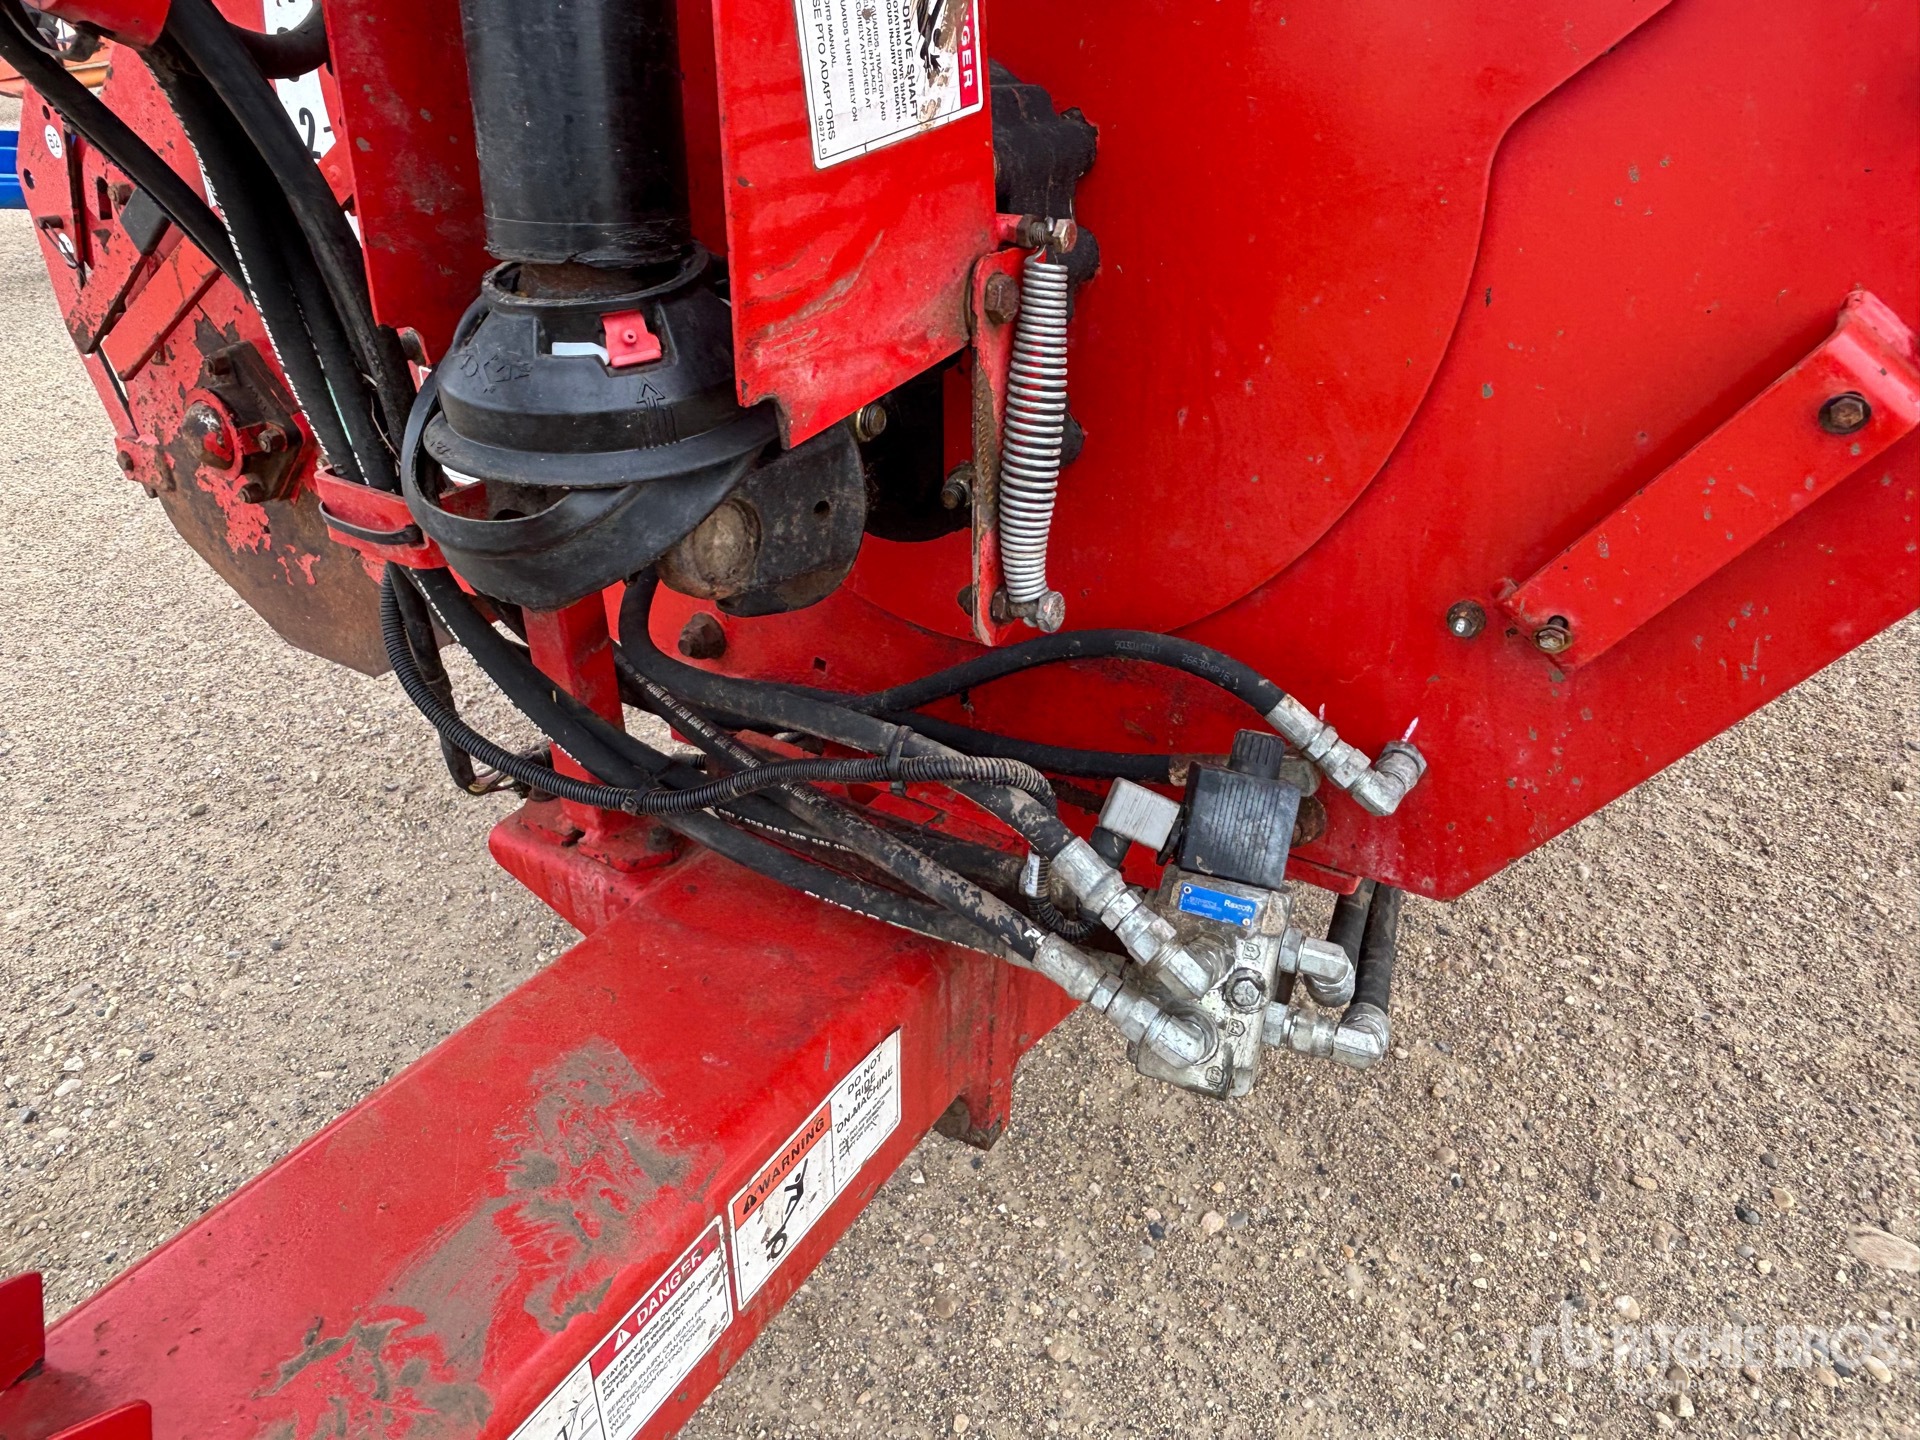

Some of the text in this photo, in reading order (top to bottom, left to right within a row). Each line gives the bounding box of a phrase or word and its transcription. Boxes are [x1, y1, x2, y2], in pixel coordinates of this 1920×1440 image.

[816, 23, 827, 55] PTO
[827, 22, 837, 68] MANUAL
[843, 37, 853, 66] TURN
[888, 27, 897, 66] INJURY
[902, 5, 918, 119] DRIVE SHAFT
[847, 68, 856, 104] FREELY
[859, 43, 870, 96] ATTACHED
[876, 52, 885, 99] TRACTOR
[819, 59, 836, 141] ADAPTORS
[851, 105, 859, 122] ON
[864, 97, 871, 109] AT
[879, 101, 887, 122] AND
[847, 1051, 883, 1095] DO NOT
[854, 1071, 876, 1101] RIDE
[836, 1113, 852, 1134] ON
[852, 1065, 893, 1118] MACHINE
[759, 1117, 825, 1194] WARNING
[637, 1248, 703, 1326] DANGER
[601, 1280, 696, 1387] STAY AWAY FROM OVERHEAD
[664, 1341, 679, 1361] CAN
[602, 1364, 630, 1395] POWER
[629, 1342, 650, 1365] LINES
[604, 1387, 617, 1402] OR
[616, 1355, 646, 1389] FOLDING
[609, 1394, 642, 1430] WITHOUT
[641, 1347, 683, 1394] CONTACTING
